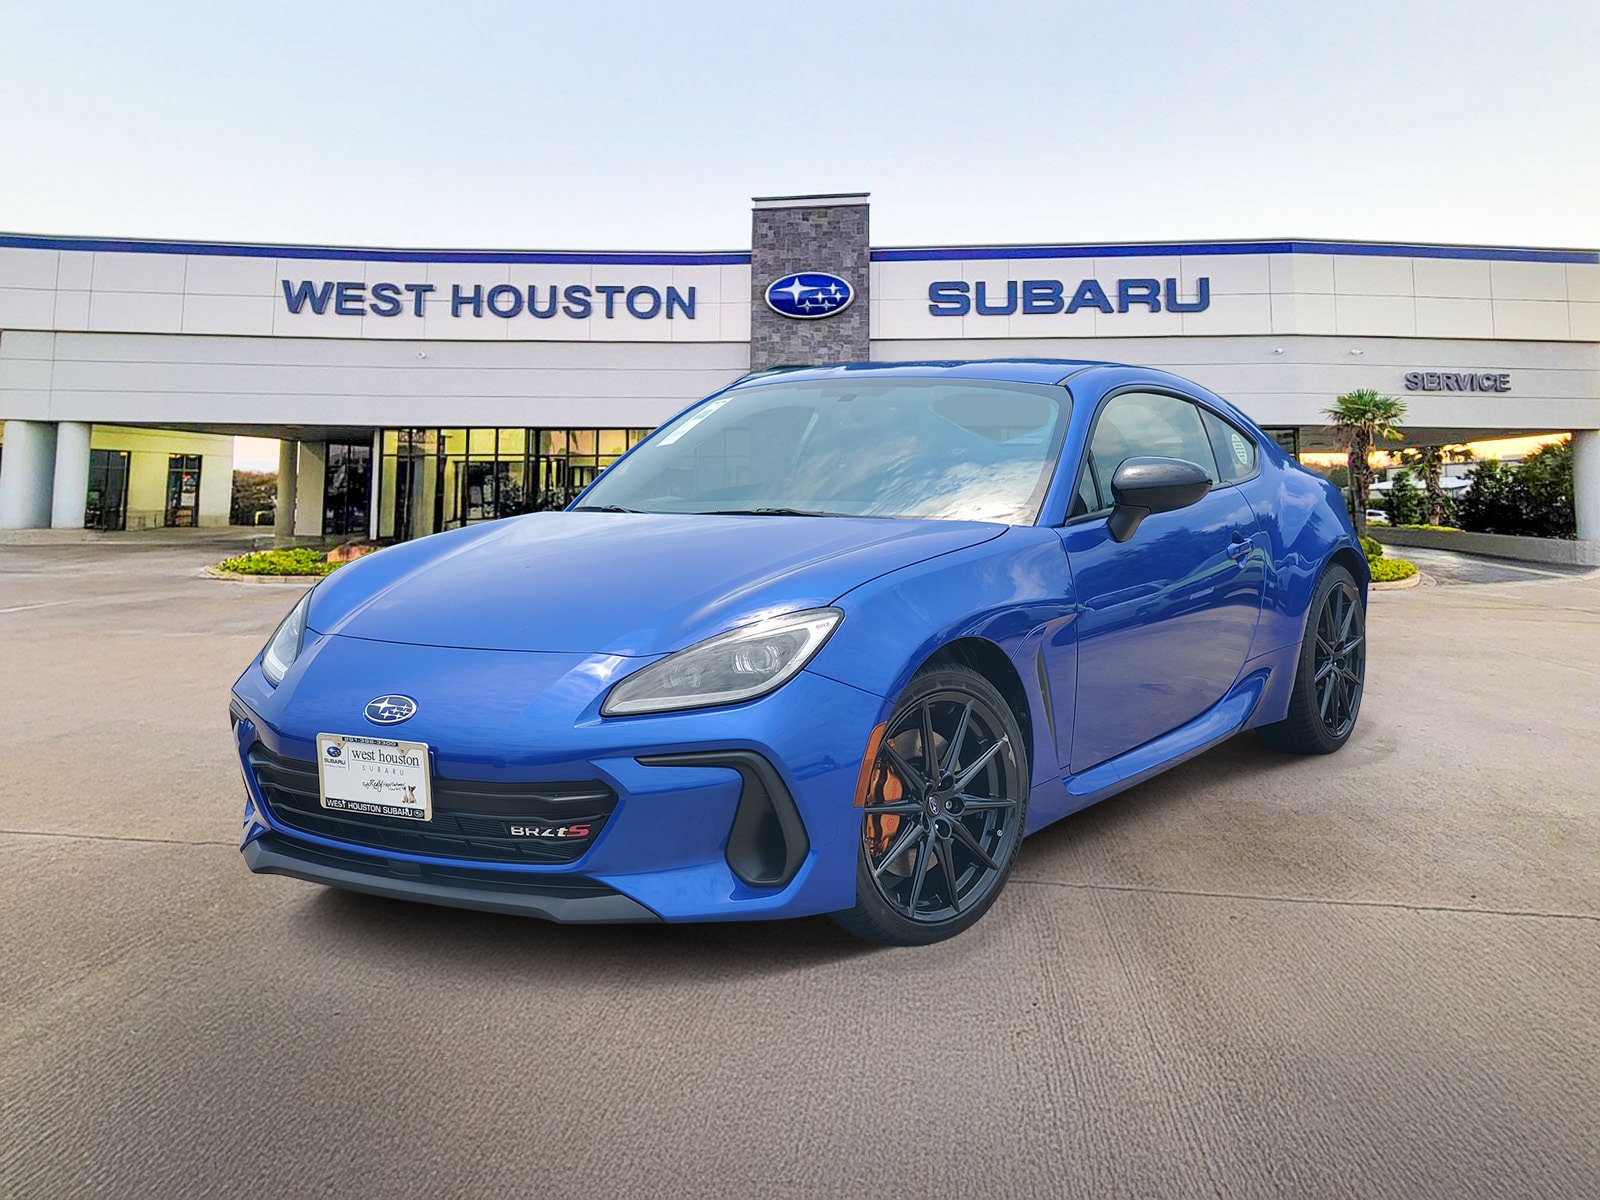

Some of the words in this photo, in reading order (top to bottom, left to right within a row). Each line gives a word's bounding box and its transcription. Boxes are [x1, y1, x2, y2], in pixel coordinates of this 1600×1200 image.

[281, 280, 436, 317] WEST
[451, 284, 697, 320] HOUSTON
[928, 277, 1210, 316] SUBARU
[1405, 372, 1512, 393] SERVICE
[352, 750, 375, 761] west
[362, 765, 404, 776] SUBARU
[326, 799, 346, 808] WEST
[347, 802, 381, 813] HOUSTON
[382, 807, 413, 817] SUBARU
